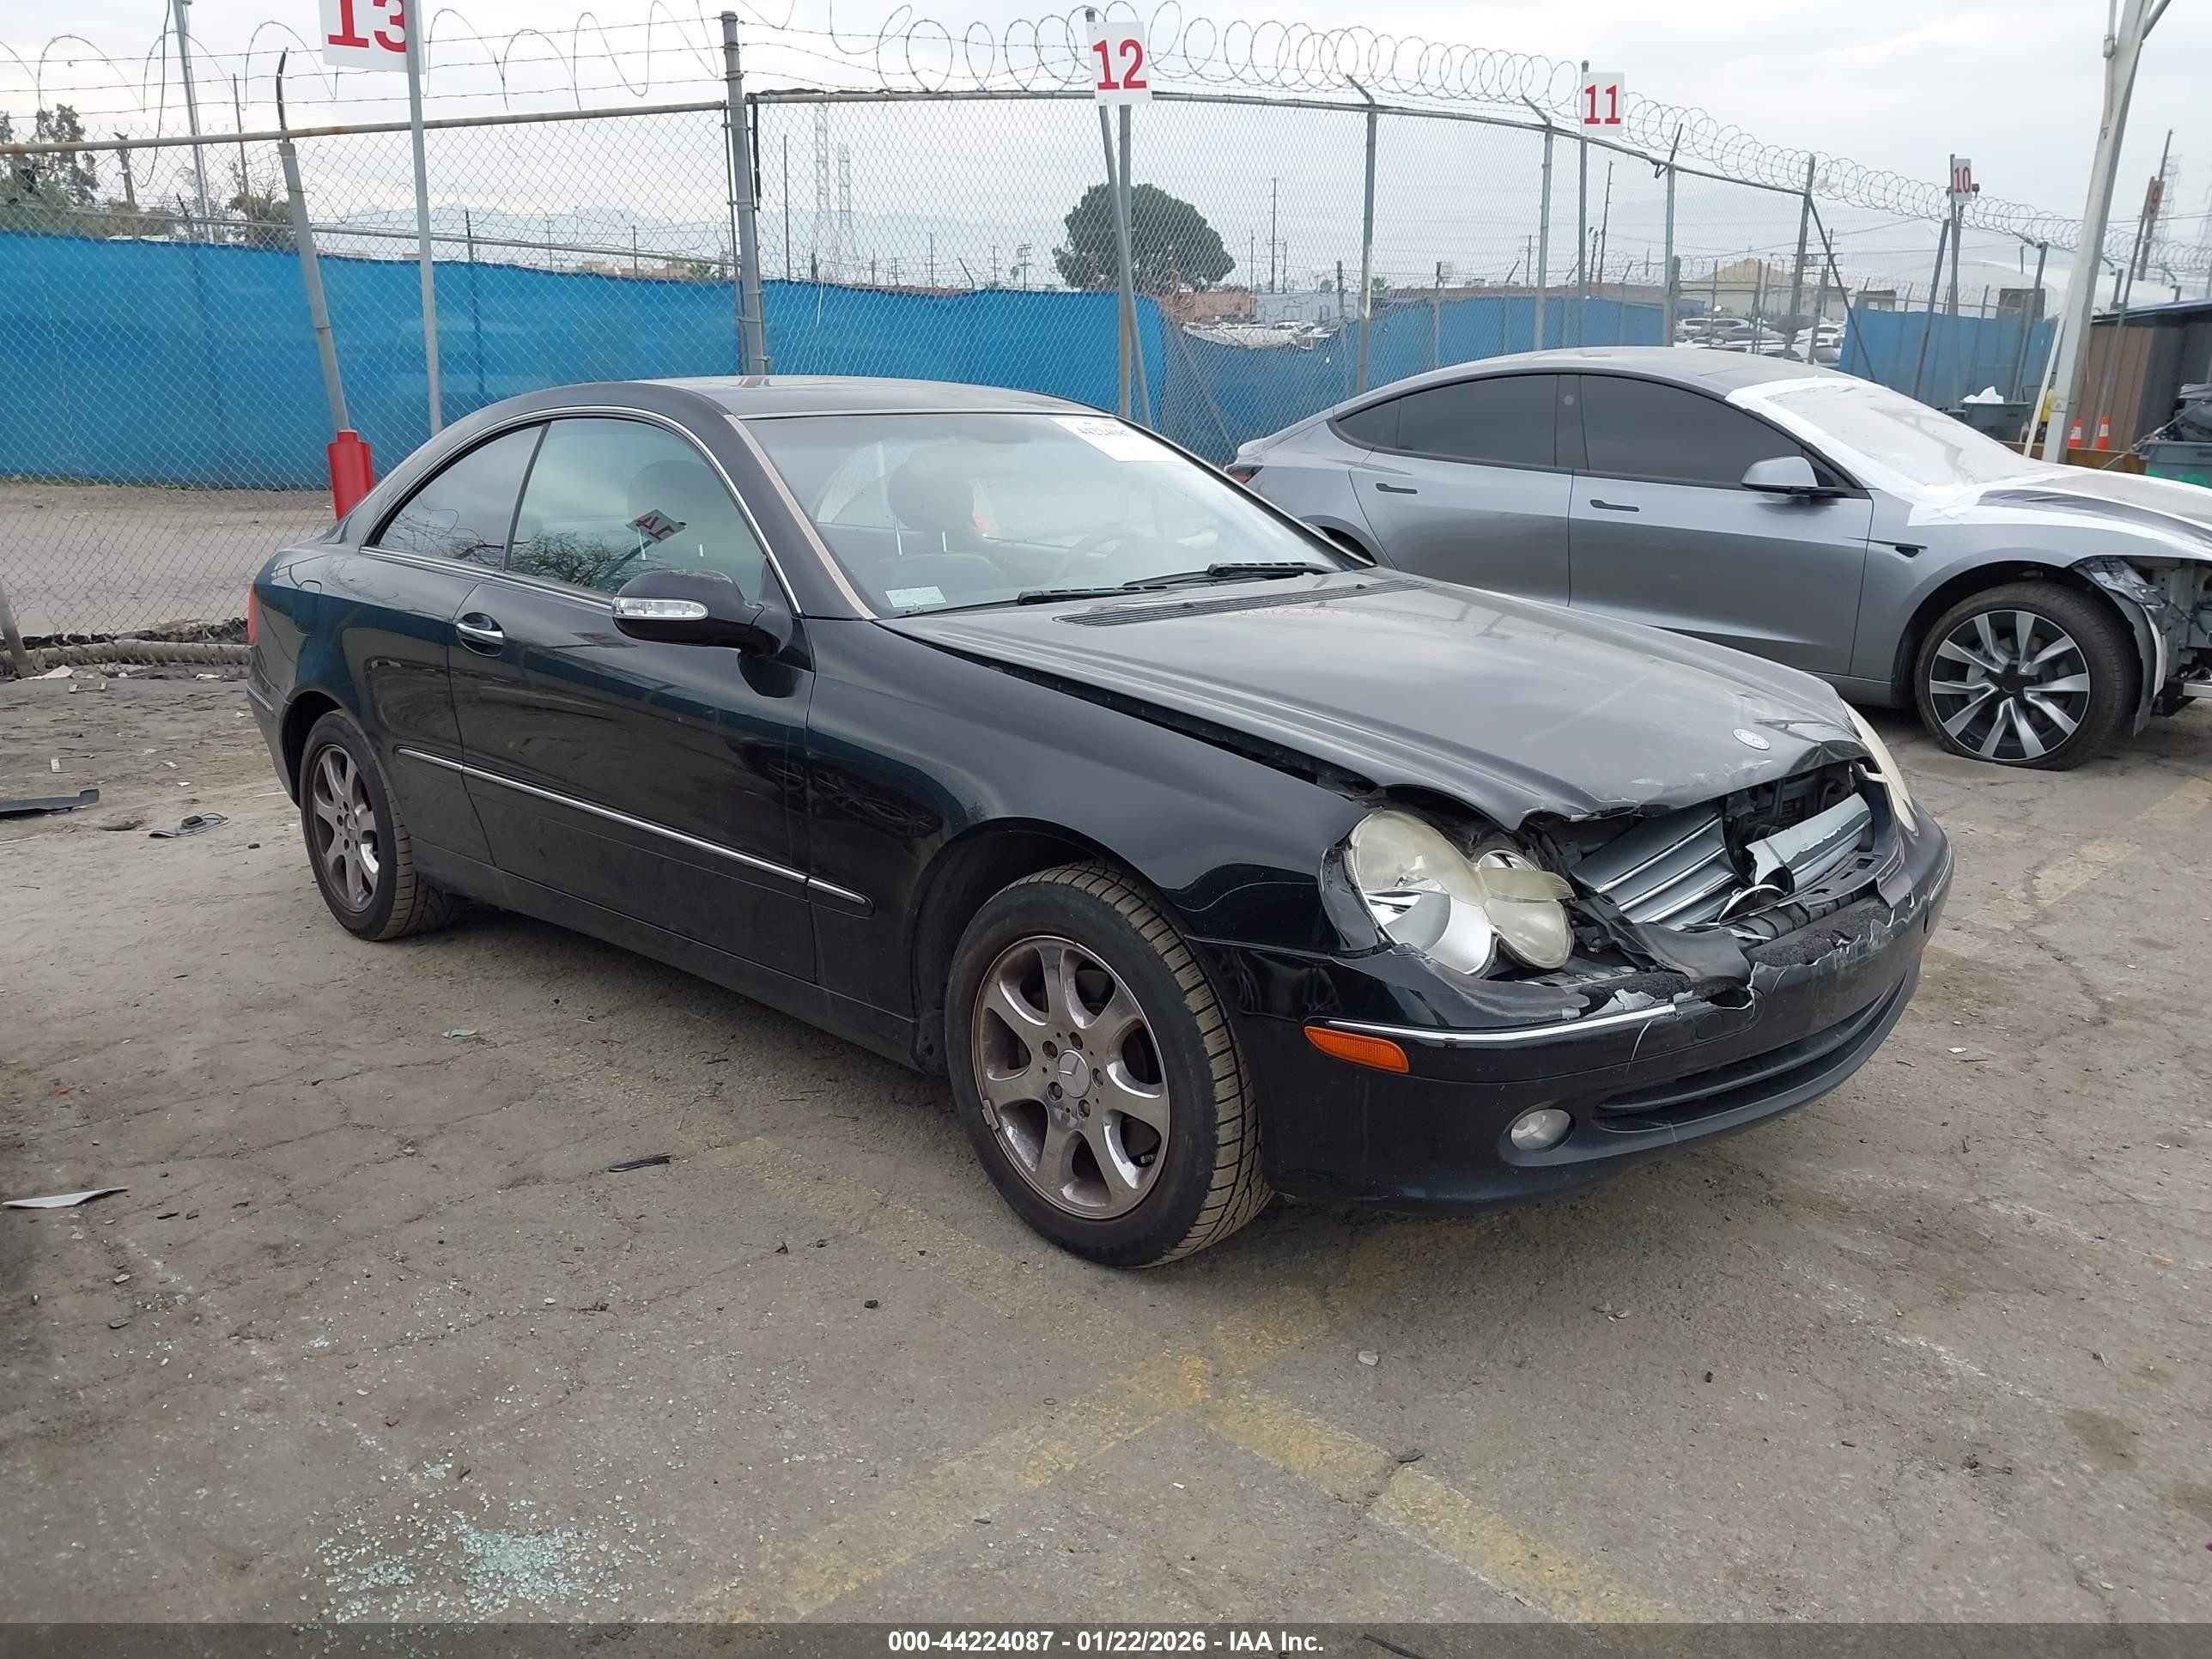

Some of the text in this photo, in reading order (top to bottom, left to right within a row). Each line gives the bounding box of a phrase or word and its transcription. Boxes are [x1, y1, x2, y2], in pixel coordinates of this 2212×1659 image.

[1092, 39, 1147, 90] 12
[1583, 83, 1621, 125] 11
[1954, 166, 1972, 193] 10
